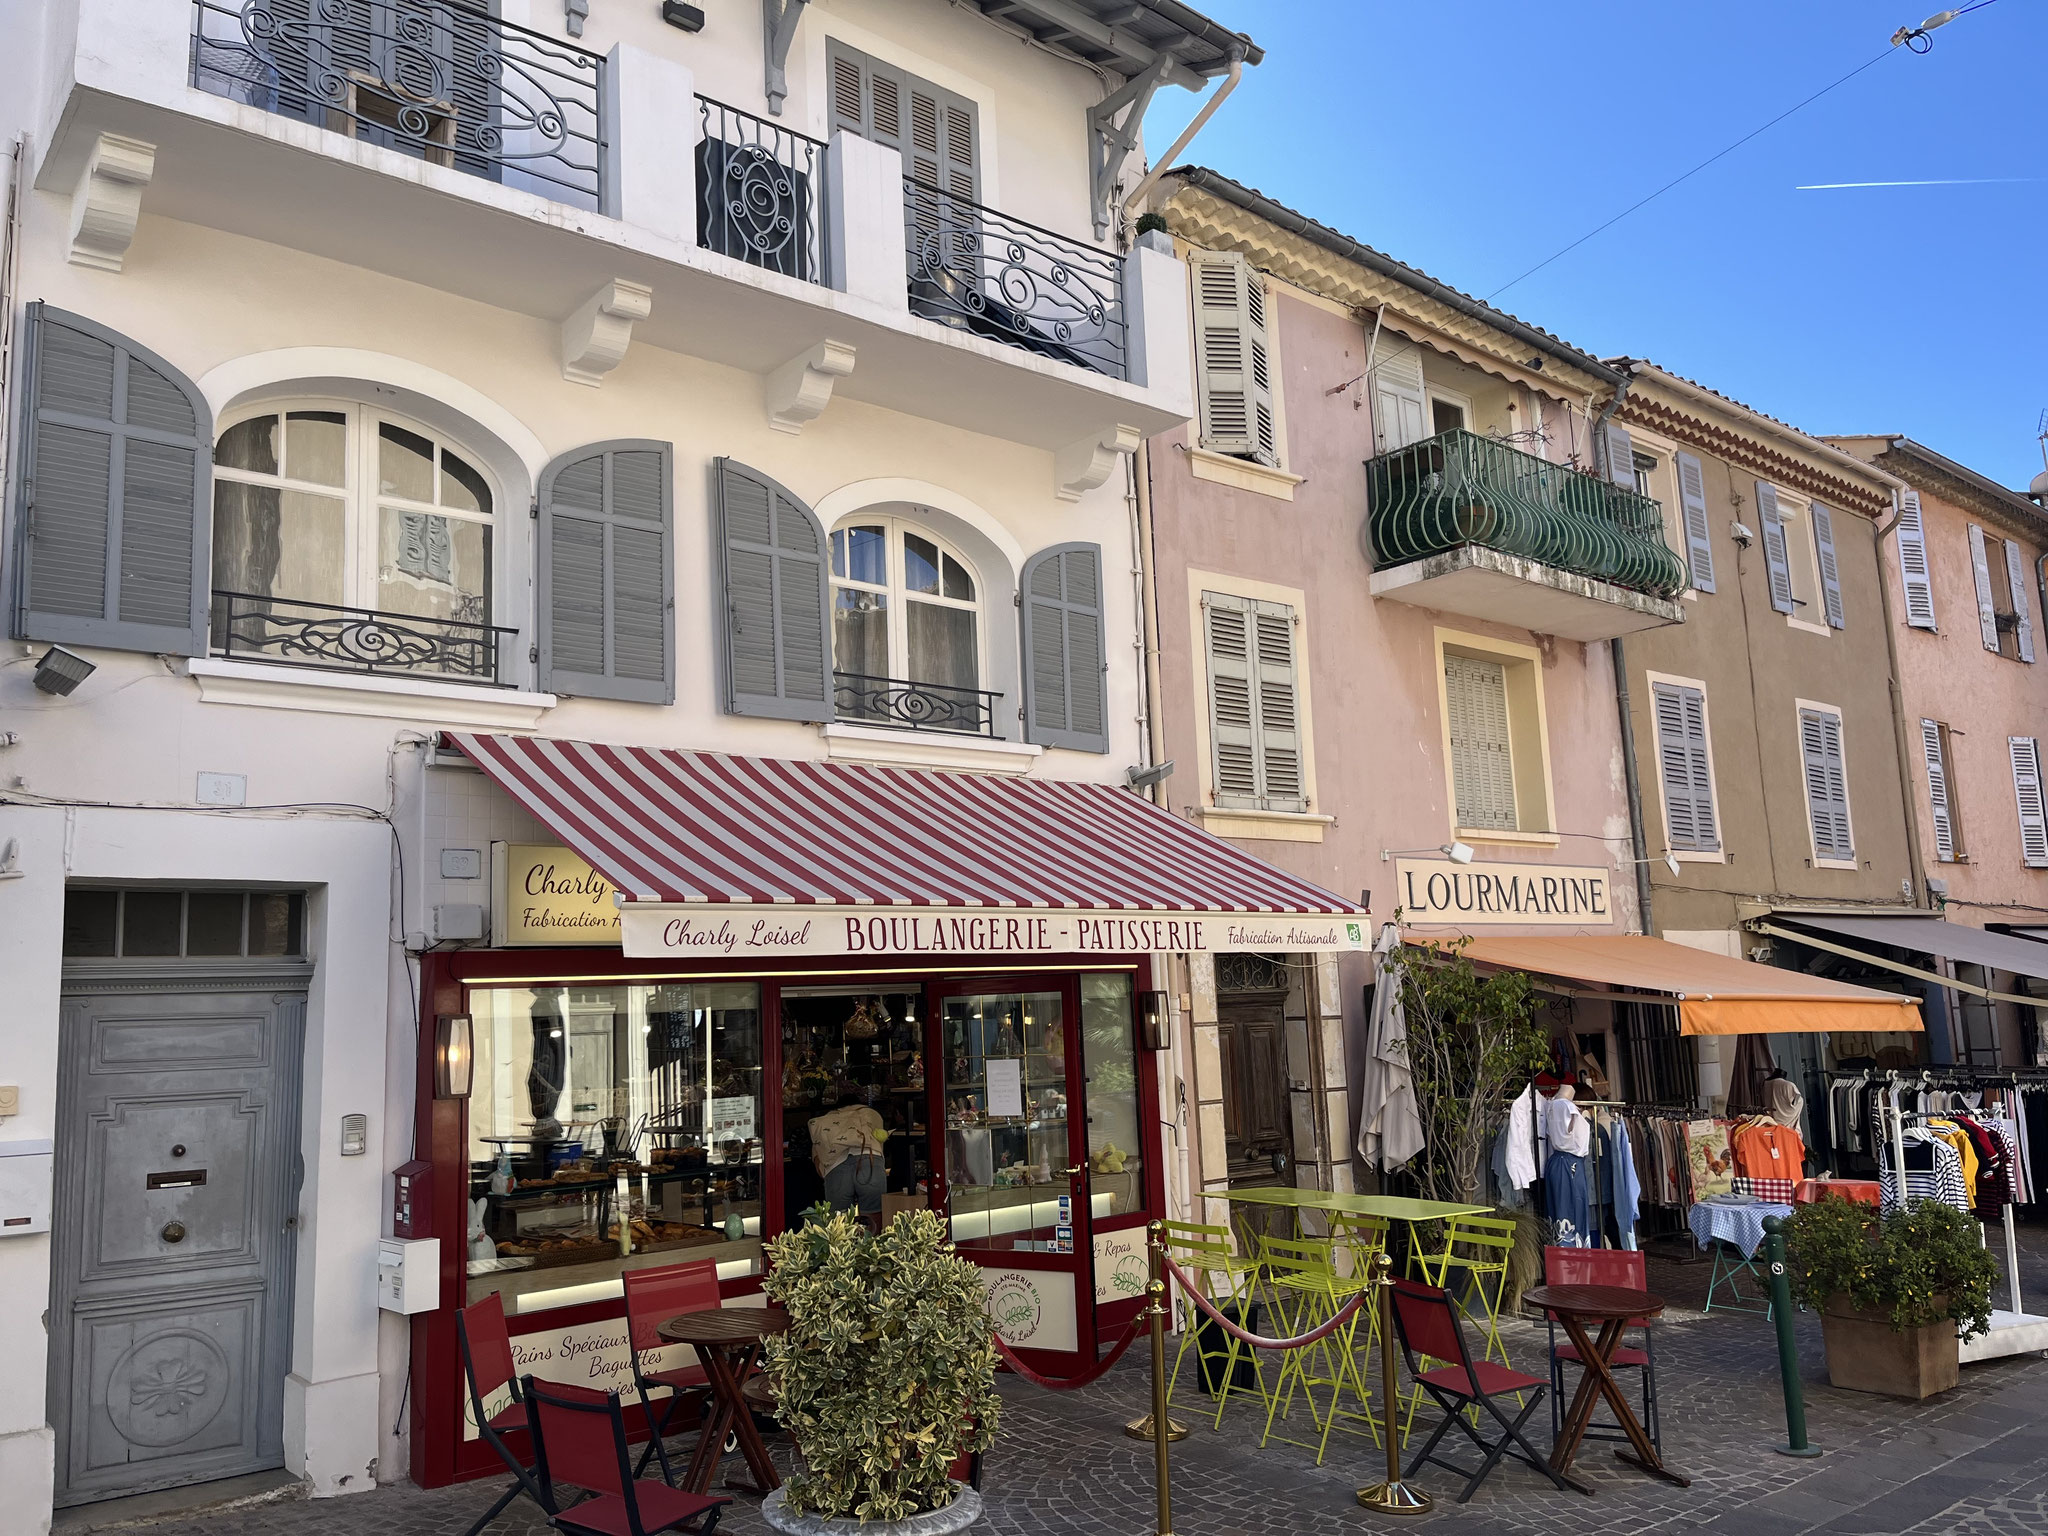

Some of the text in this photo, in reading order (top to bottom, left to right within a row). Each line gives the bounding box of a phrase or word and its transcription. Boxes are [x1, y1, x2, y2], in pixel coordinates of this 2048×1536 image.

[525, 863, 608, 904] Charly
[1404, 871, 1607, 916] LOURMARINE
[523, 907, 609, 928] Fabrication
[663, 918, 739, 954] Charly
[745, 919, 811, 947] Loisel
[845, 917, 1052, 951] BOULANGERIE
[1077, 919, 1207, 950] PATISSERIE
[1228, 926, 1284, 945] Fabrication
[1286, 927, 1339, 945] Artisanale
[1105, 1239, 1132, 1258] Repas
[988, 1273, 1041, 1305] BOULANGERIE BIO
[993, 1321, 1037, 1344] Charly Loisel
[511, 1345, 554, 1366] Pains
[560, 1334, 631, 1360] Spéciaux
